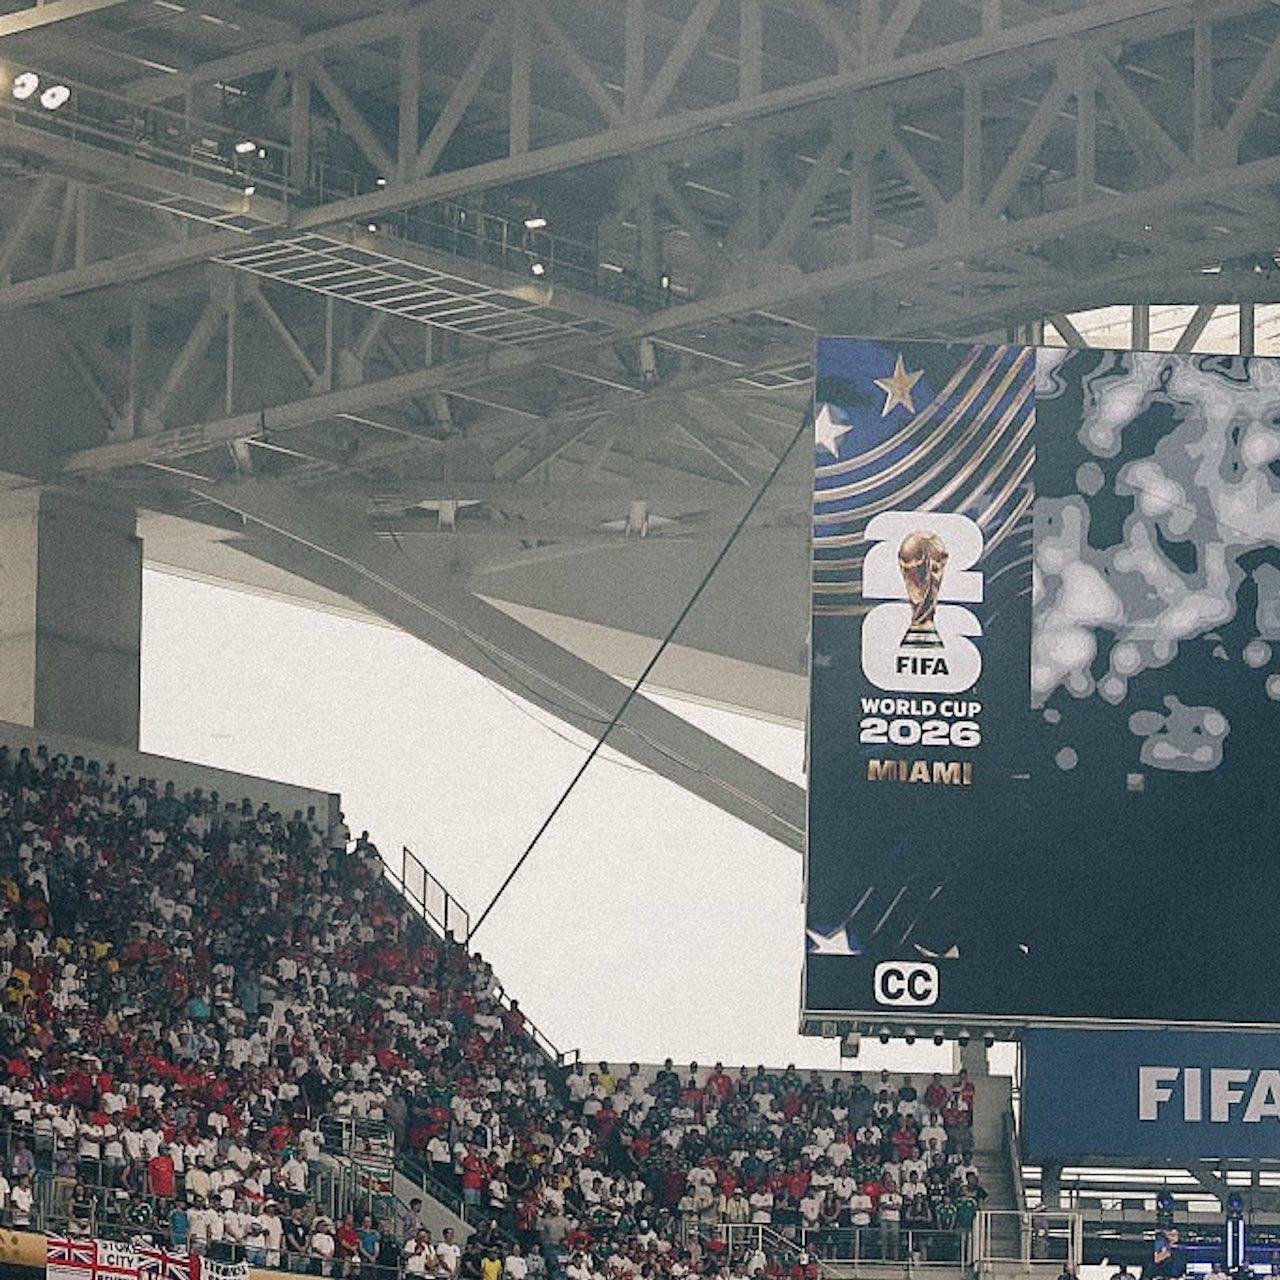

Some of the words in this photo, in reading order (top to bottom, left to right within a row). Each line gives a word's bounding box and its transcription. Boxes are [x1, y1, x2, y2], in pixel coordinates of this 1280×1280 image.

[896, 655, 949, 676] FIFA
[861, 697, 933, 717] WORLD
[941, 701, 982, 718] CUP
[860, 720, 982, 747] 2026
[867, 759, 972, 785] MIAMI
[880, 969, 933, 1001] CC
[107, 1254, 135, 1266] CITY
